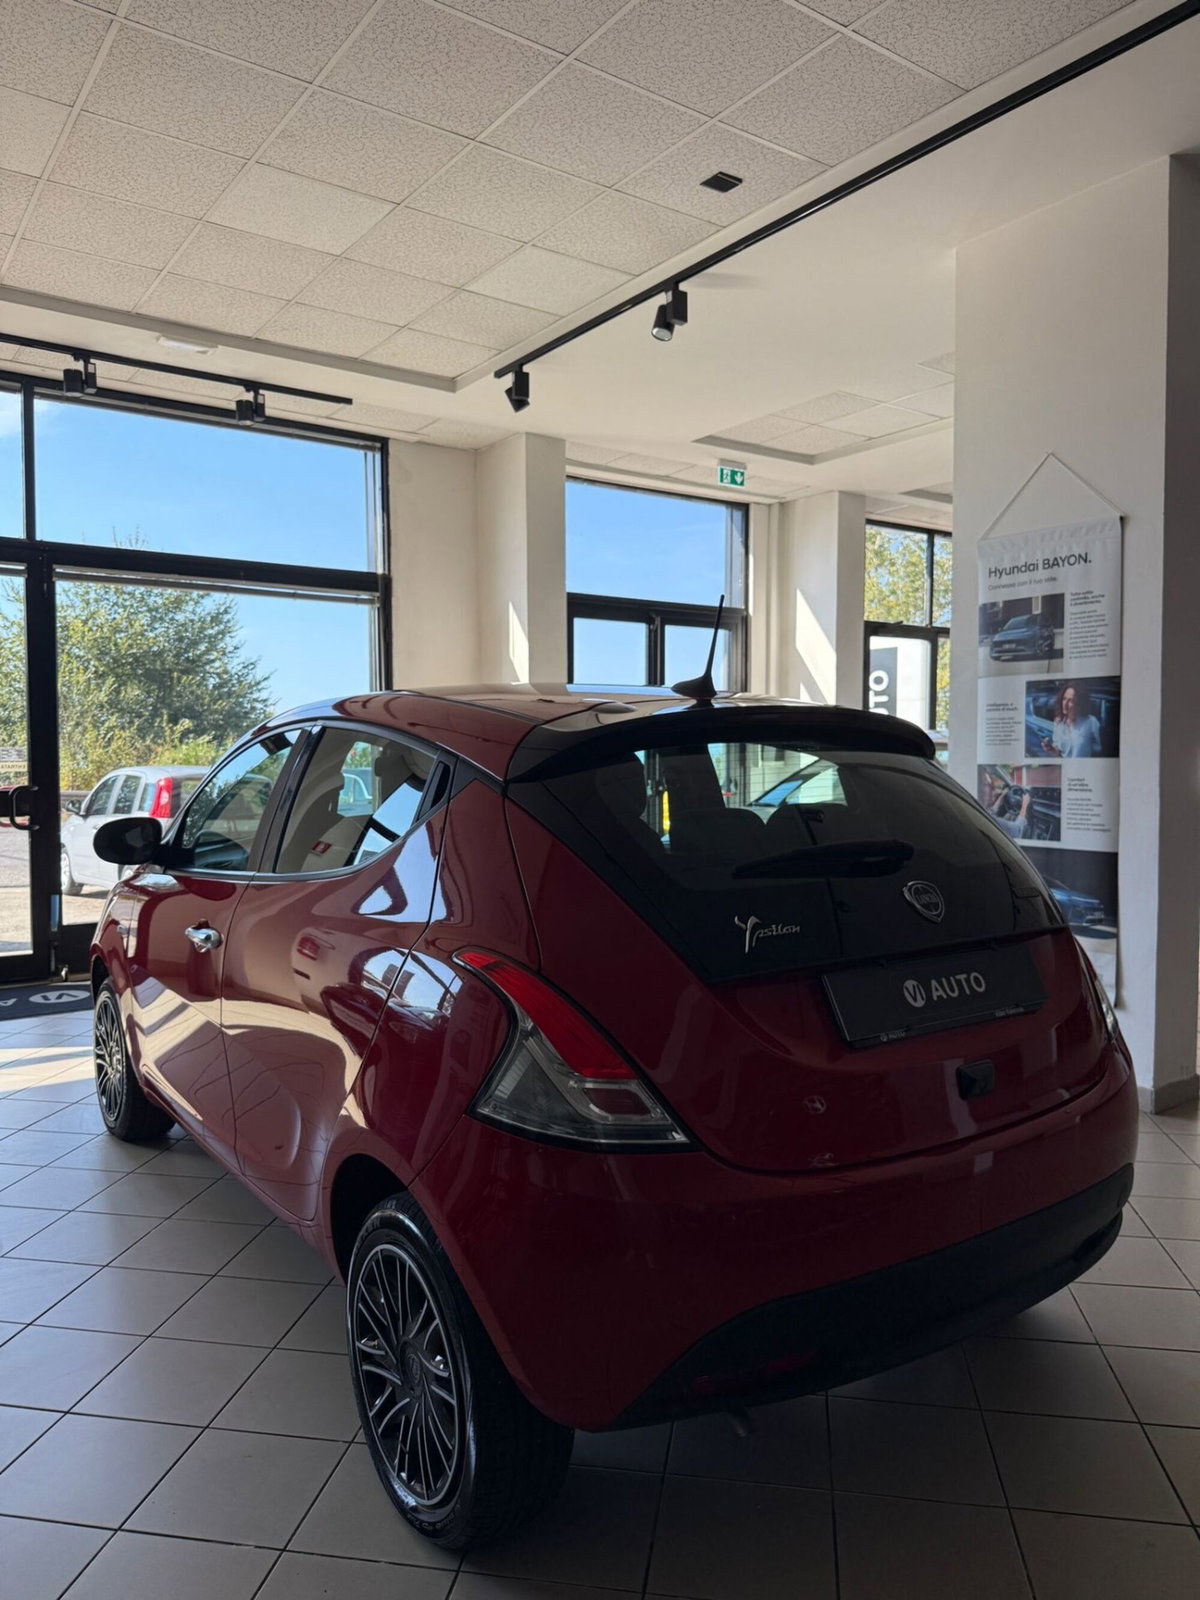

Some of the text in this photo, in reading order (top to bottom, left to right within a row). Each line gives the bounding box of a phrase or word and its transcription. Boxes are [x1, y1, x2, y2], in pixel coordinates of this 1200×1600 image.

[988, 552, 1092, 579] Hyundai BAYON.
[734, 915, 801, 954] Ypsilon
[903, 972, 986, 1007] VI AUTO
